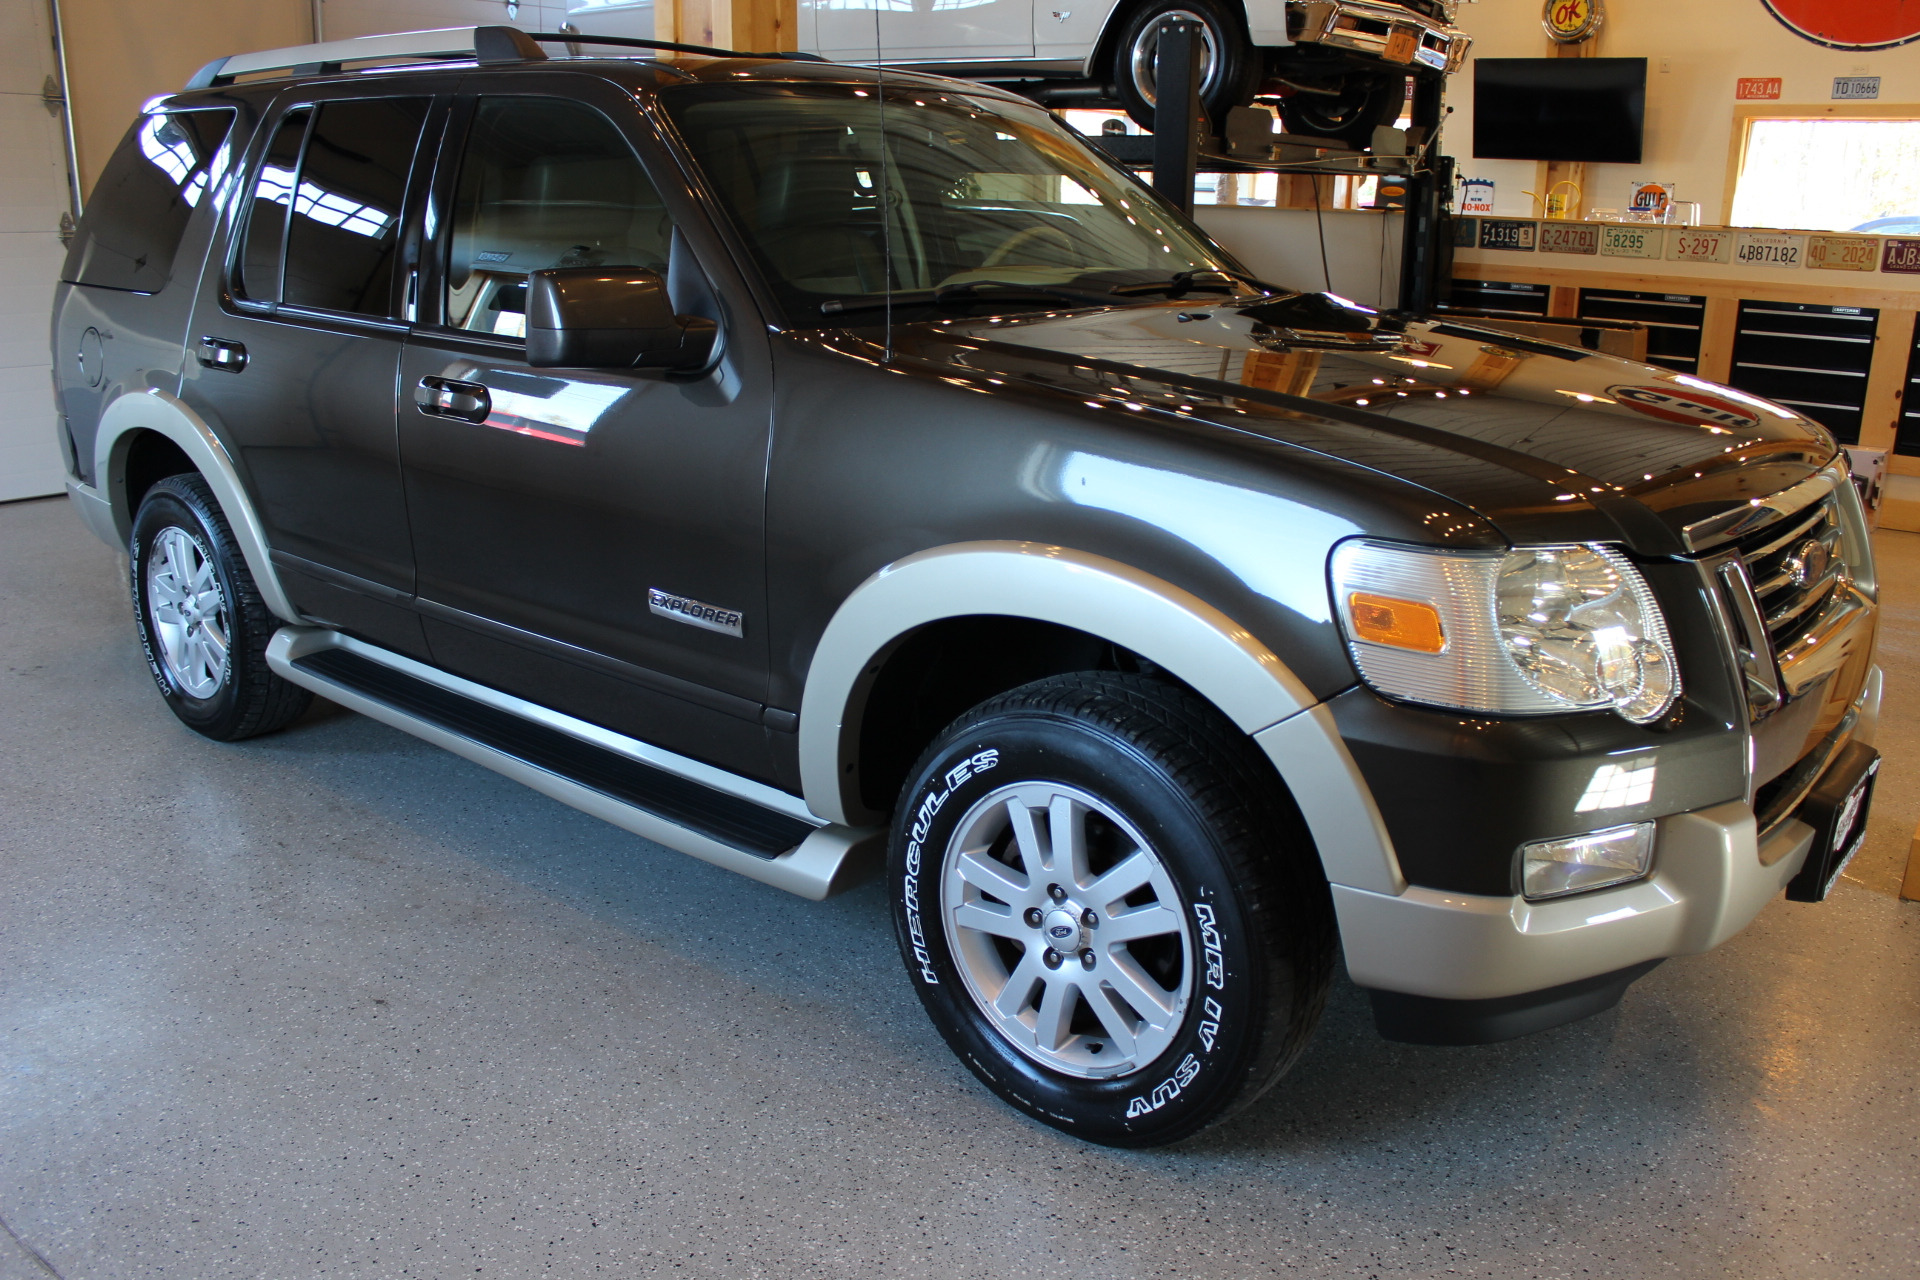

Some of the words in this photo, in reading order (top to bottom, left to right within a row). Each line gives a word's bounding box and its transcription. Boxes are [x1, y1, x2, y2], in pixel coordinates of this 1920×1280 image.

[1556, 0, 1582, 24] OK
[1739, 82, 1764, 95] 1743
[1766, 82, 1779, 95] AA
[1835, 82, 1849, 94] TD
[1851, 82, 1877, 94] 10666
[1635, 191, 1667, 207] GULF
[1490, 227, 1519, 242] 1319
[1613, 234, 1644, 249] 8295
[1752, 237, 1788, 245] CALIFORNIA
[1738, 244, 1798, 263] 4B87182
[650, 593, 739, 627] EXPLORER
[904, 748, 999, 985] HERCULES
[1126, 1053, 1201, 1119] SUV
